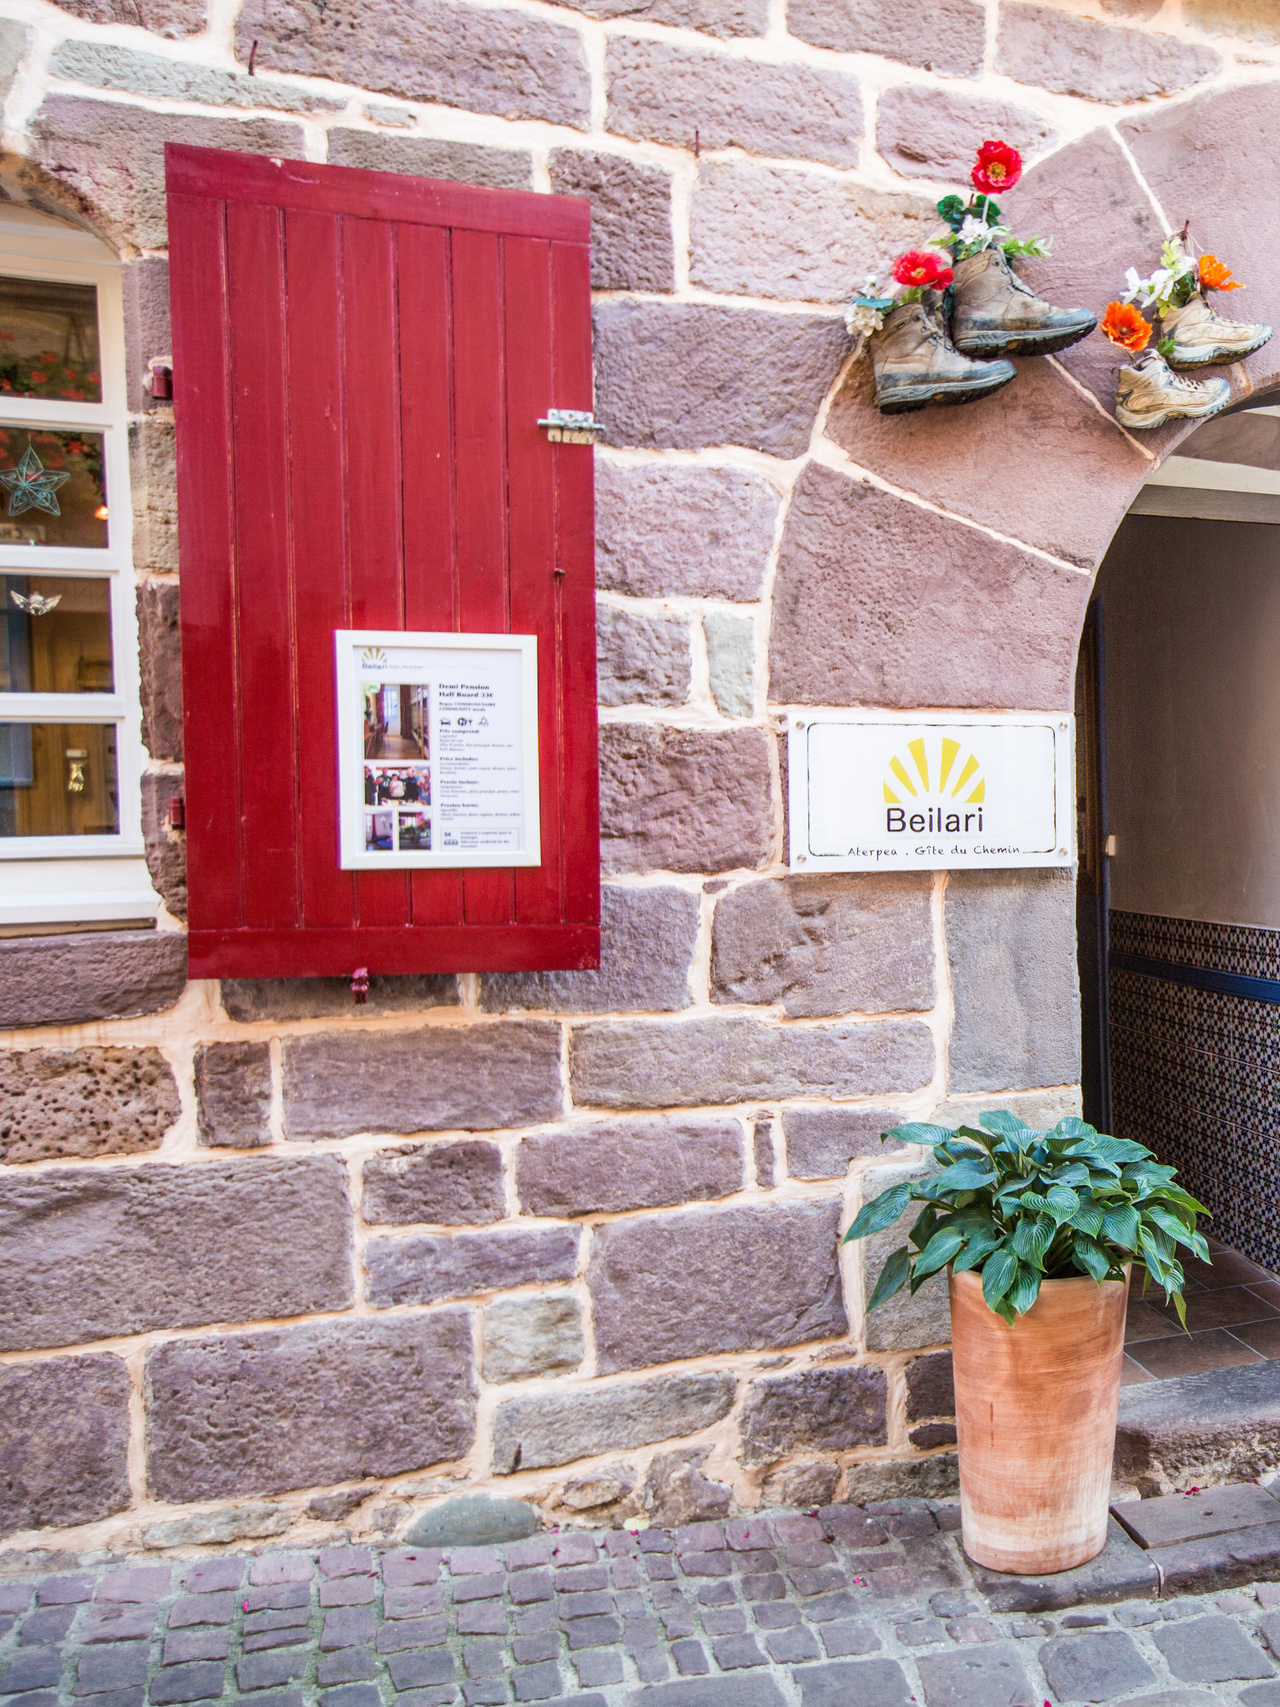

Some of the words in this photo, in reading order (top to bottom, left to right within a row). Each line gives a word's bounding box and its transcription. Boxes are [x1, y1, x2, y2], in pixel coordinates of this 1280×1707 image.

[886, 807, 983, 833] Beilari
[848, 847, 898, 861] Aterpea
[915, 845, 944, 855] Gîte
[951, 845, 967, 855] du
[974, 845, 1021, 855] Chemin
